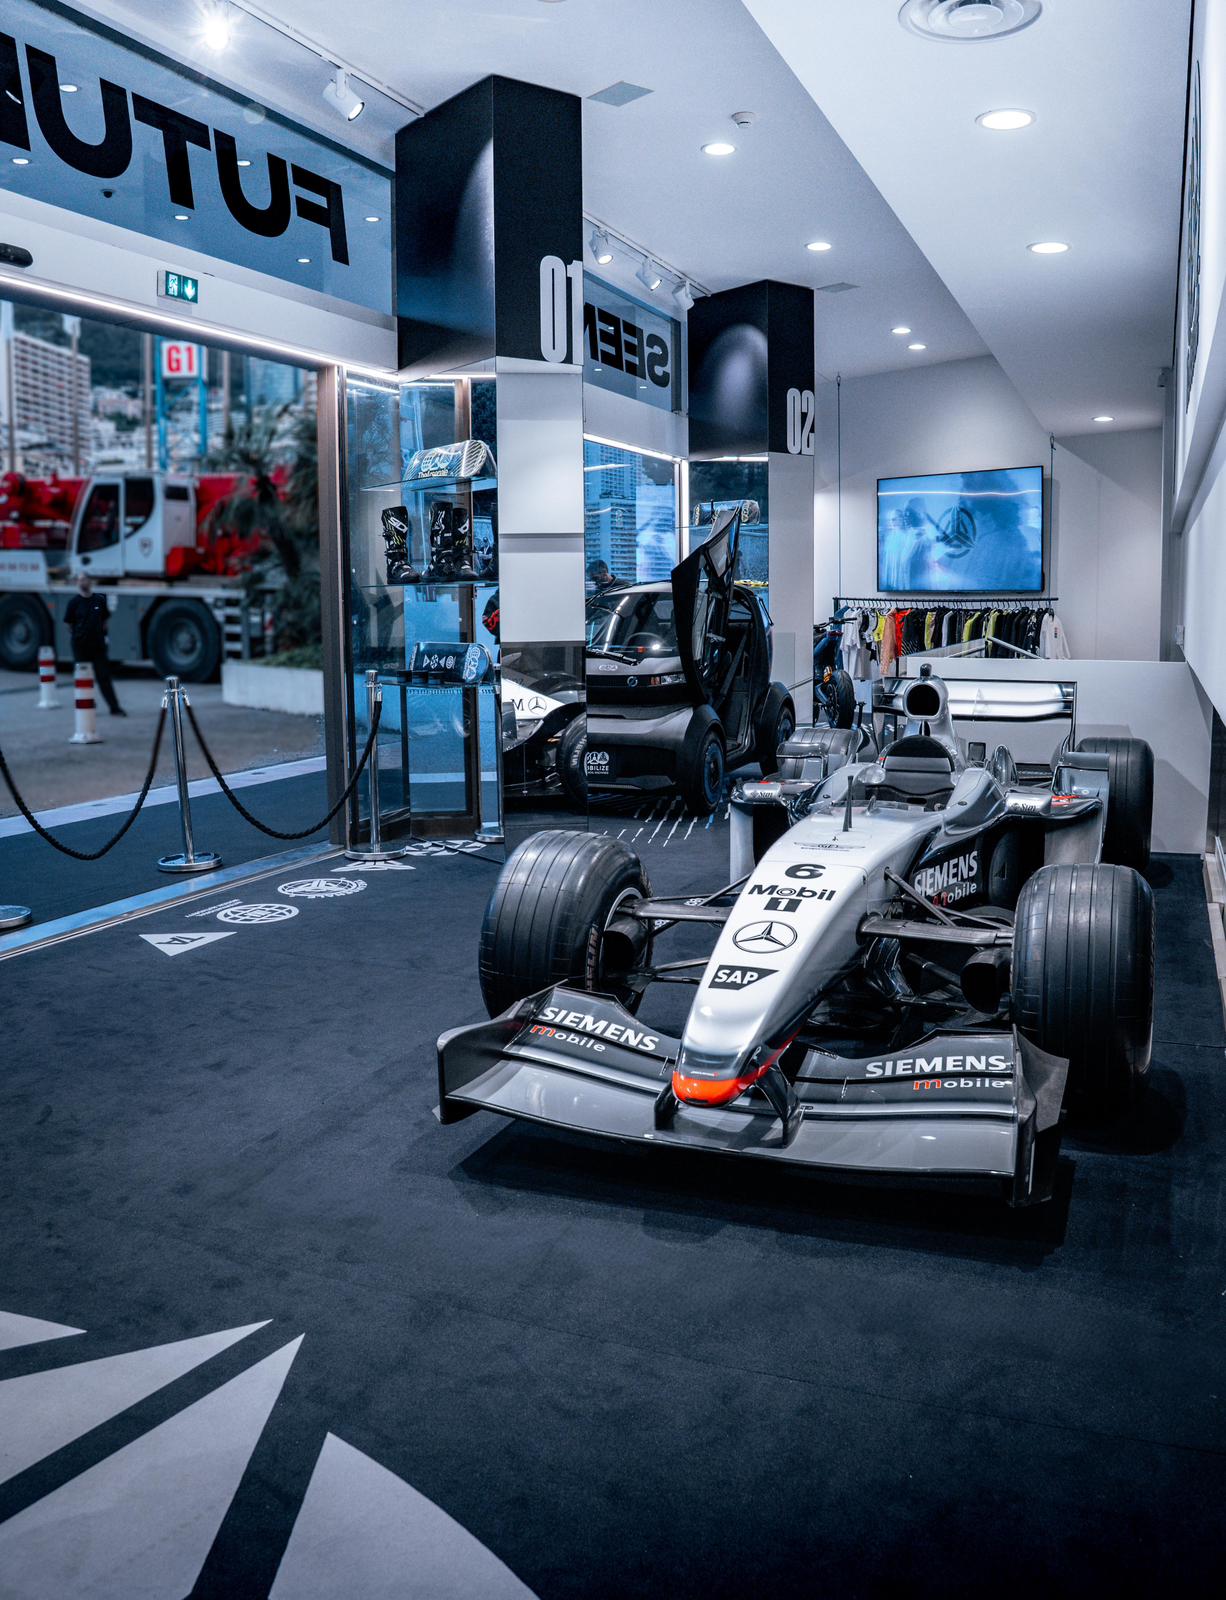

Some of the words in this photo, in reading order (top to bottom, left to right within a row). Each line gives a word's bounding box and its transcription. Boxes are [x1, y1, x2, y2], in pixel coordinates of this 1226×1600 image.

[540, 255, 583, 366] 01
[167, 345, 194, 372] G1
[787, 388, 815, 456] 02
[785, 863, 826, 879] 6
[914, 851, 978, 899] SIEMENS
[748, 884, 836, 901] Mobil
[714, 969, 759, 985] SAP
[530, 1024, 606, 1052] mobile
[538, 1007, 659, 1051] SIEMENS
[865, 1055, 1007, 1078] SIEMENS
[913, 1077, 1006, 1091] mobile
